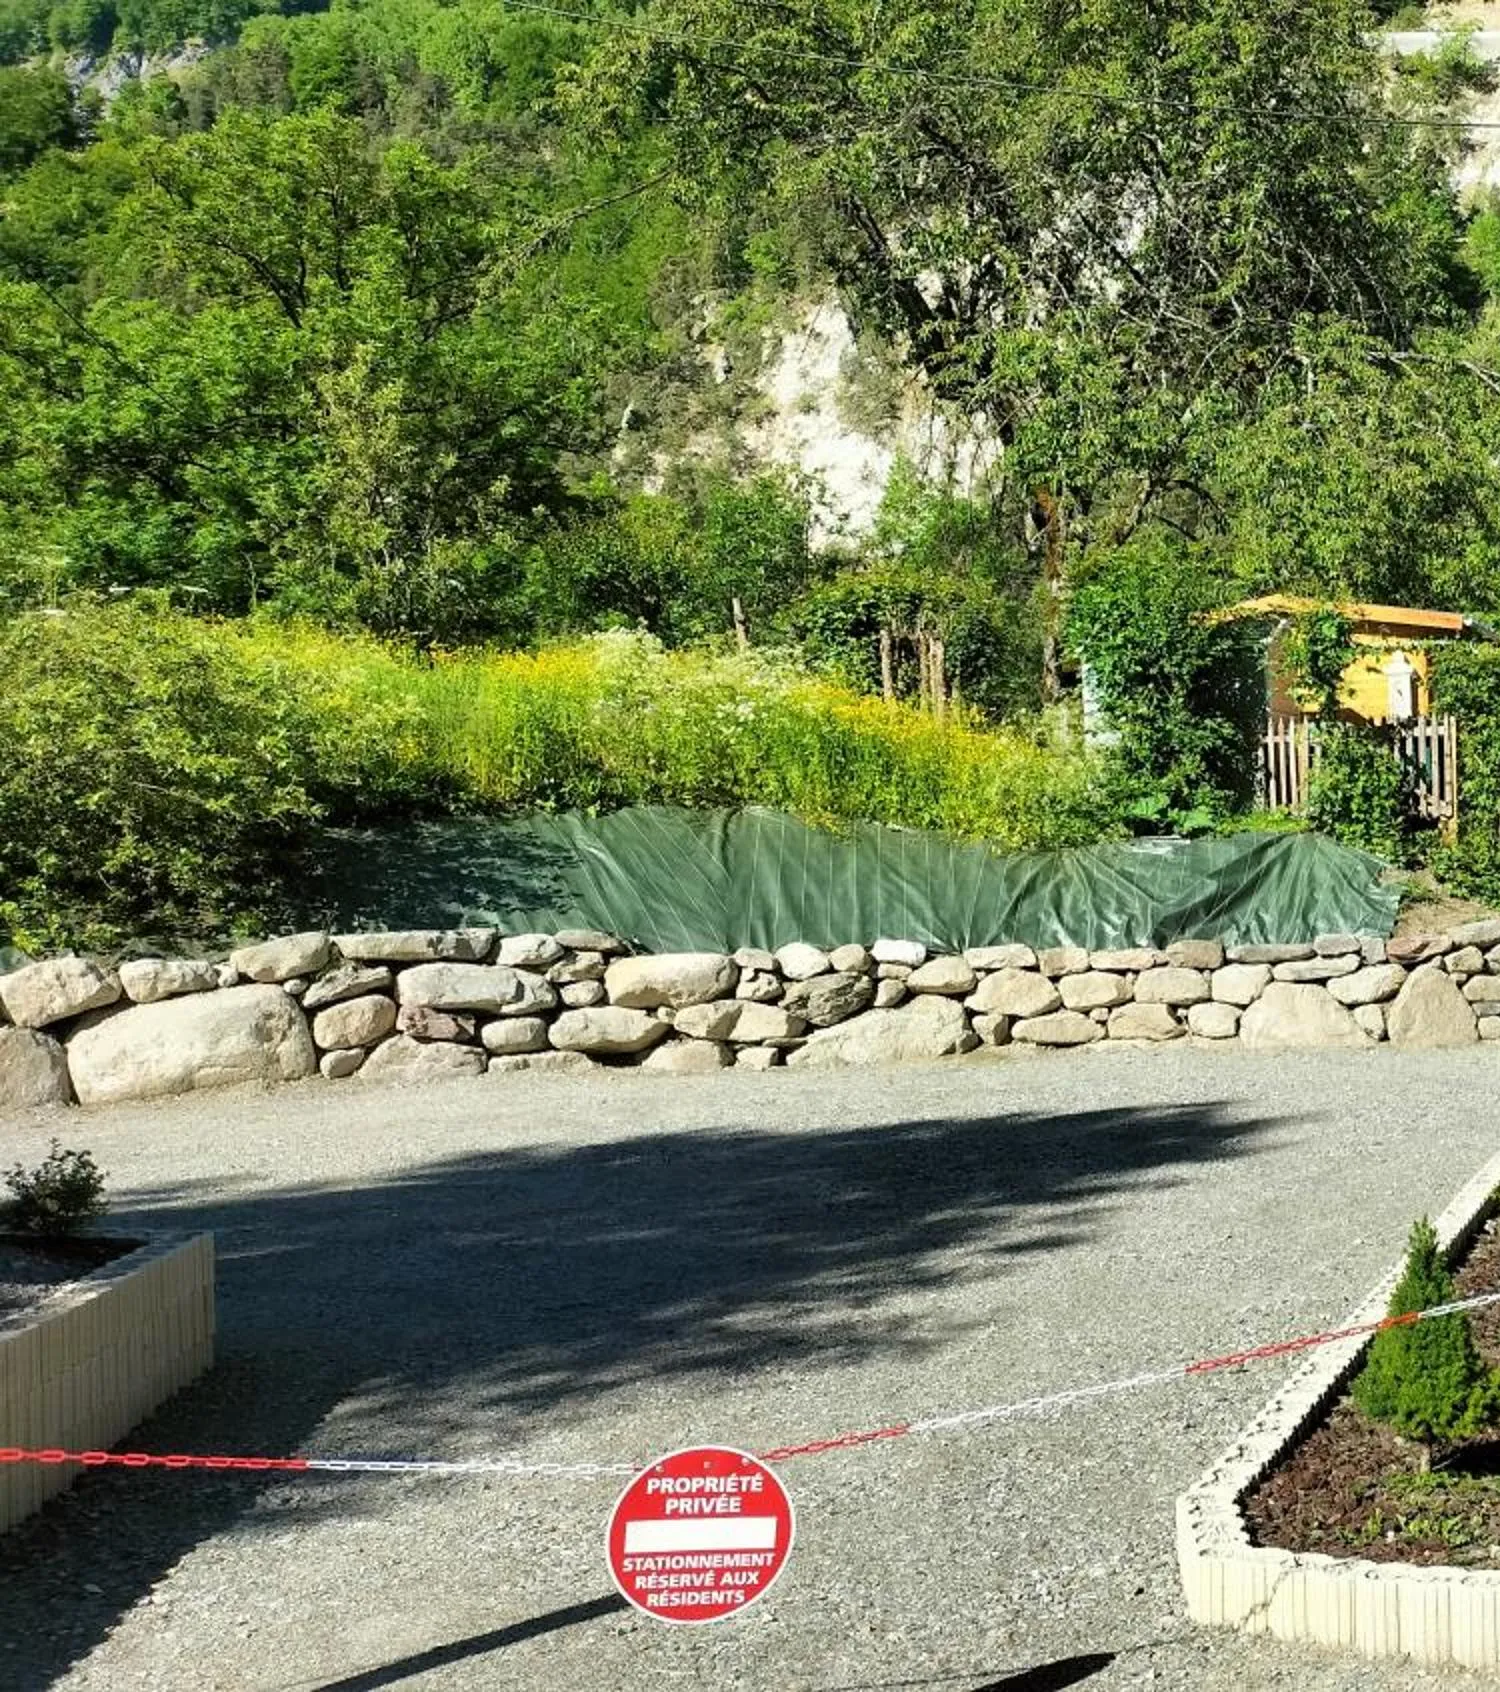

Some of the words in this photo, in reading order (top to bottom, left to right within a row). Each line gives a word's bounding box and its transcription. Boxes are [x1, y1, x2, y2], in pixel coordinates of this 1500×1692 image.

[646, 1471, 764, 1495] PROPRIÉTÉ
[665, 1494, 743, 1515] PRIVÉE
[621, 1552, 776, 1573] STATIONNEMENT
[634, 1569, 716, 1590] RÉSERVÉ
[719, 1571, 760, 1587] AUX
[646, 1588, 746, 1608] RÉSIDENTS
